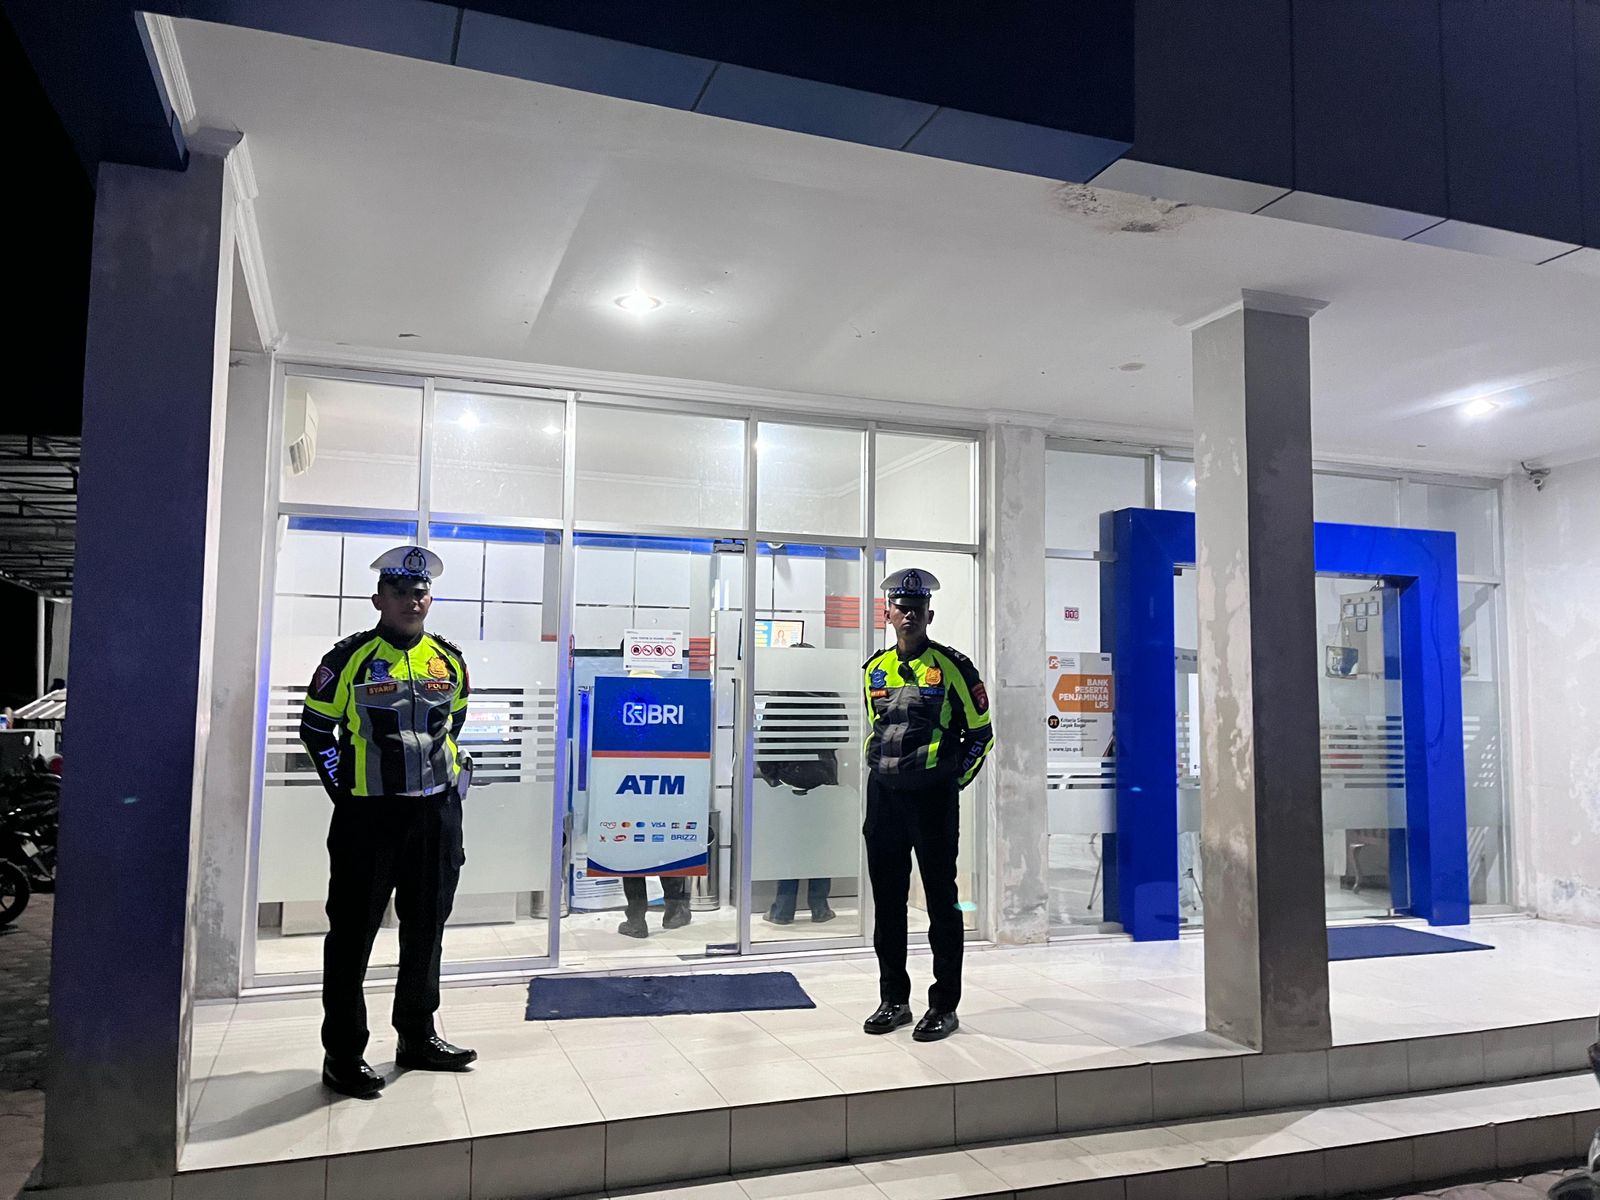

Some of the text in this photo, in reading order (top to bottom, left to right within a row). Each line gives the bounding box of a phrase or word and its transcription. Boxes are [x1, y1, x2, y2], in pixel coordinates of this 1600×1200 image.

[1059, 693, 1109, 701] PENJAMINAN
[647, 704, 684, 725] BRI
[615, 774, 685, 795] ATM
[670, 833, 697, 841] BRIZZI
